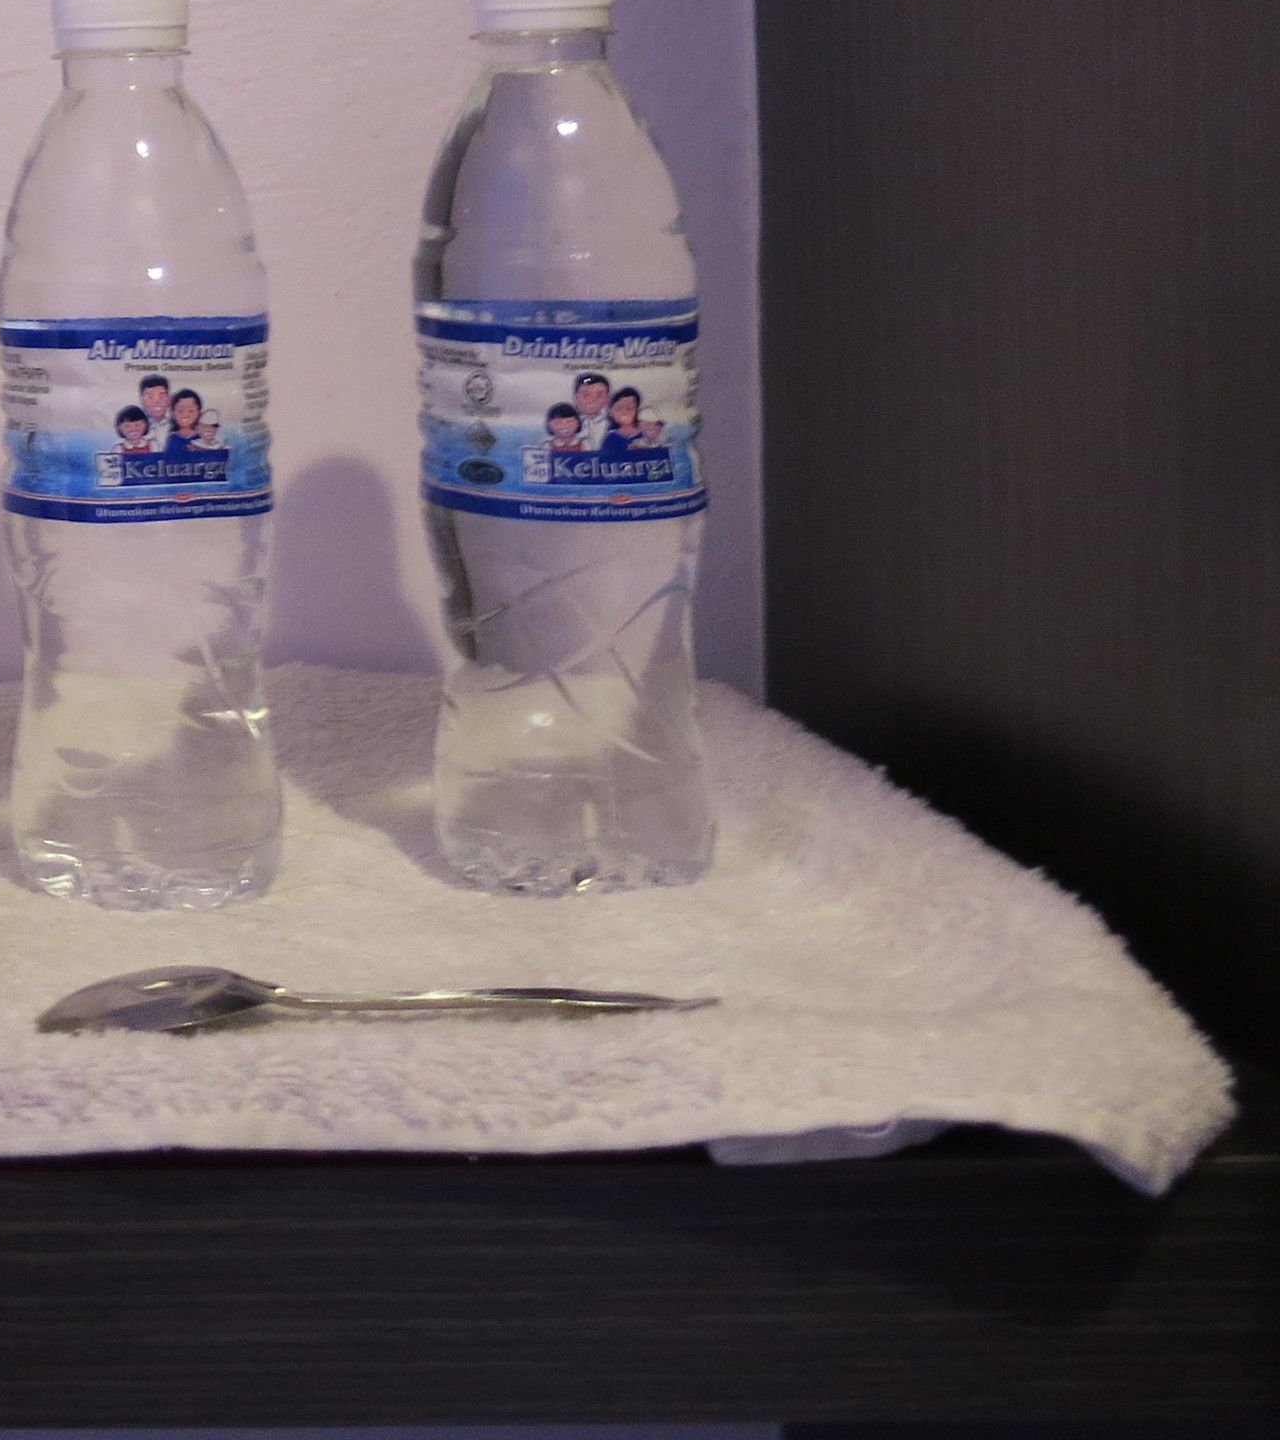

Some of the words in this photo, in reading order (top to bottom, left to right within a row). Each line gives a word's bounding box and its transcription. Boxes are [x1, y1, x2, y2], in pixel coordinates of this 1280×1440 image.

[87, 339, 127, 360] Air
[131, 339, 236, 360] Minuman
[503, 335, 617, 363] Drinking
